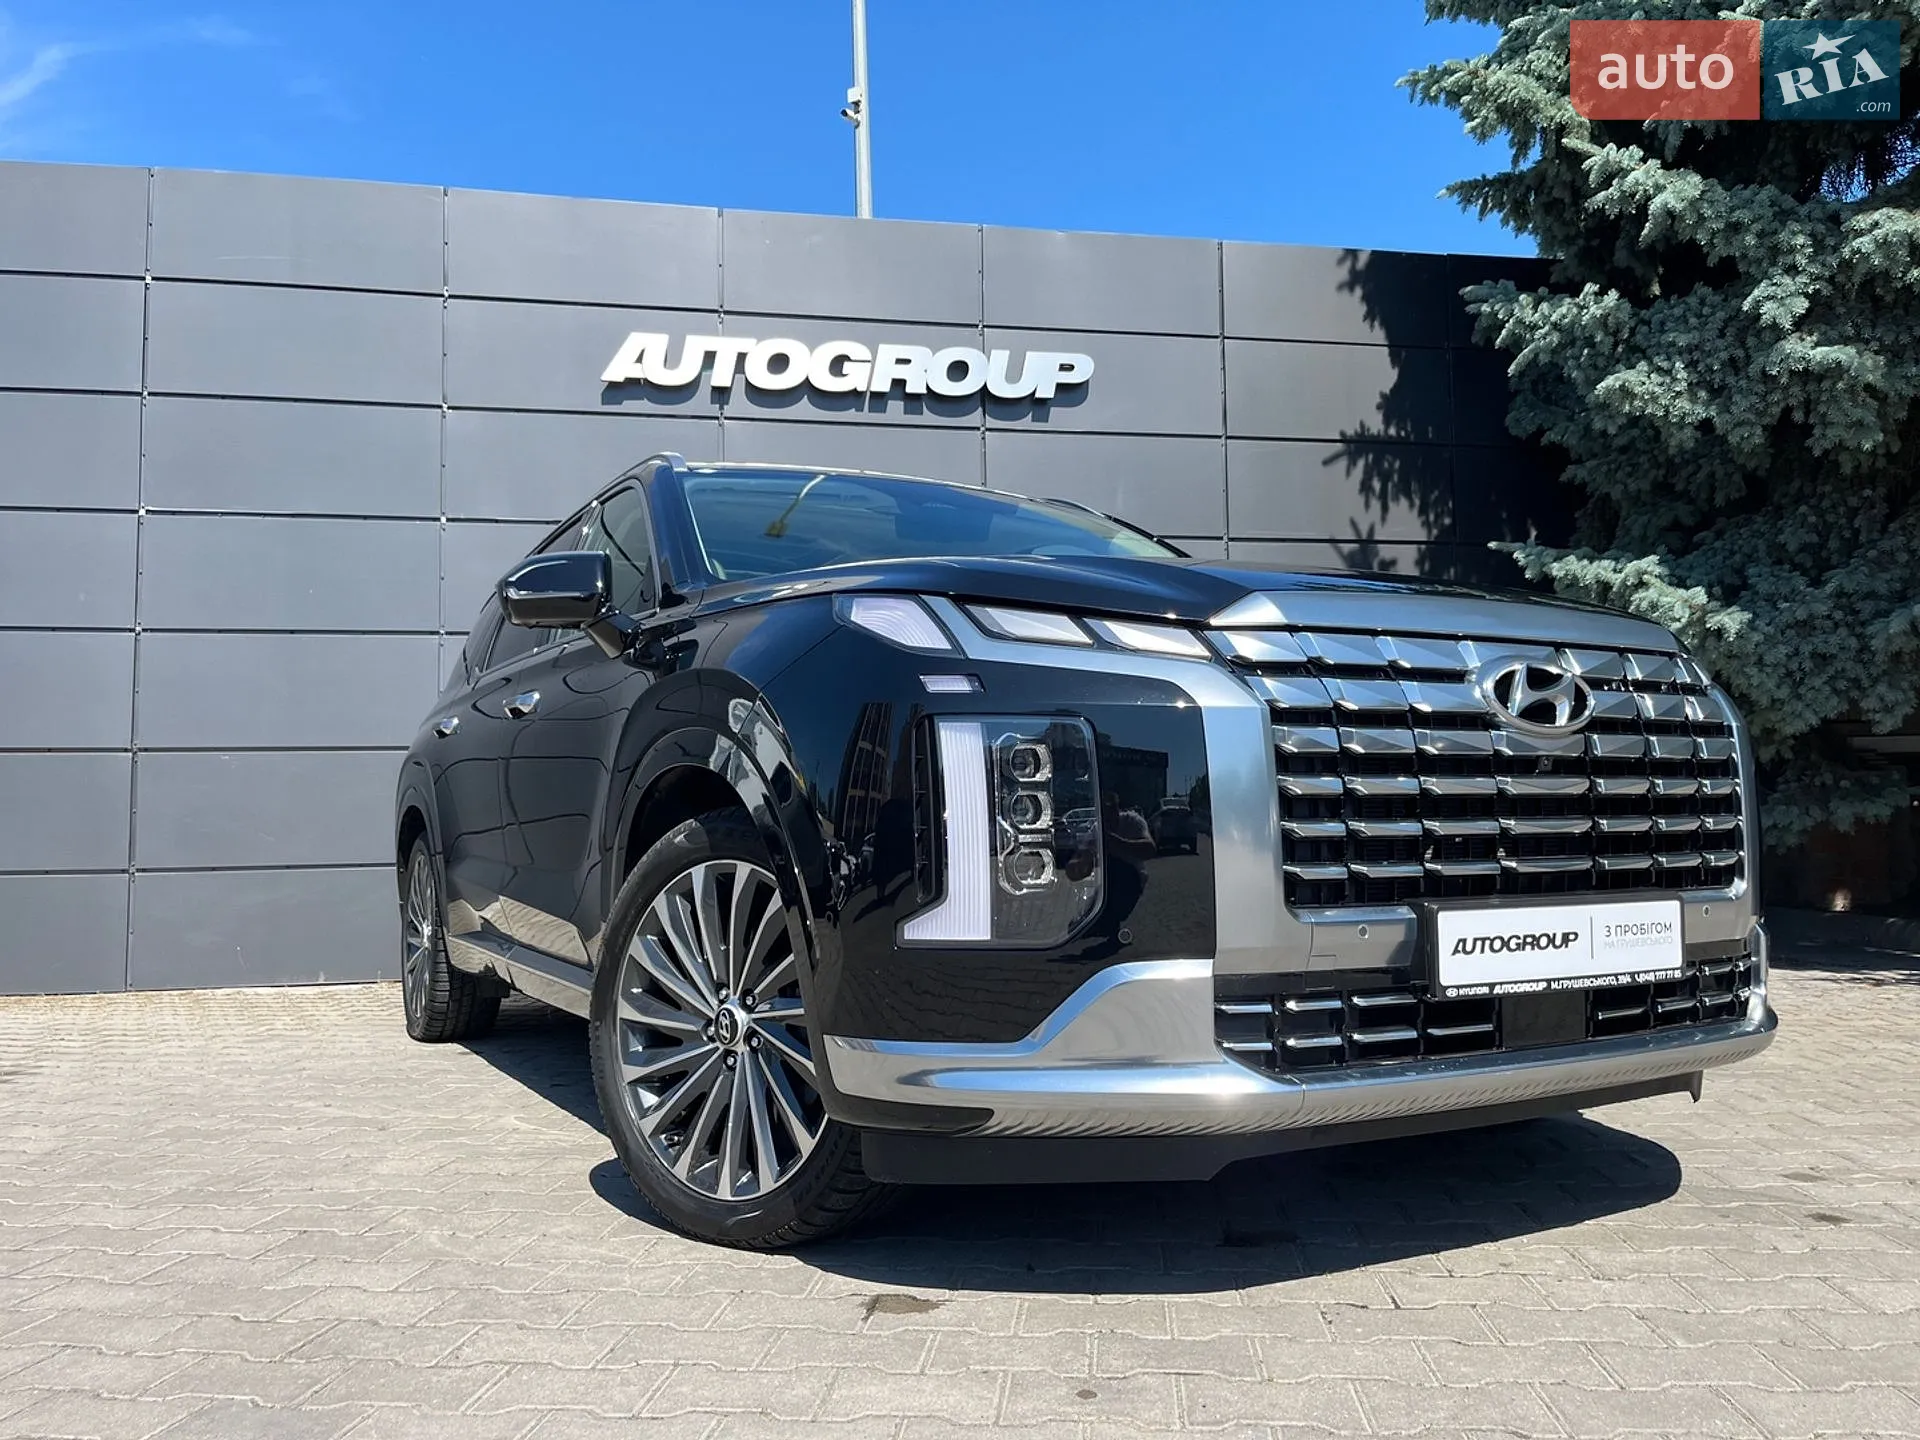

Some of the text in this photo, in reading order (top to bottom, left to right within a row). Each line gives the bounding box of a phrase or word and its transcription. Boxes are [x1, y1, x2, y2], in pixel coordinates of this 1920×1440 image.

[600, 331, 1095, 400] AUTOGROUP
[1614, 920, 1673, 937] ПРОБІГОМ
[1451, 931, 1579, 956] AUTOGROUP
[1459, 986, 1490, 996] HYUNDAI
[1493, 981, 1548, 995] AUTOGROUP
